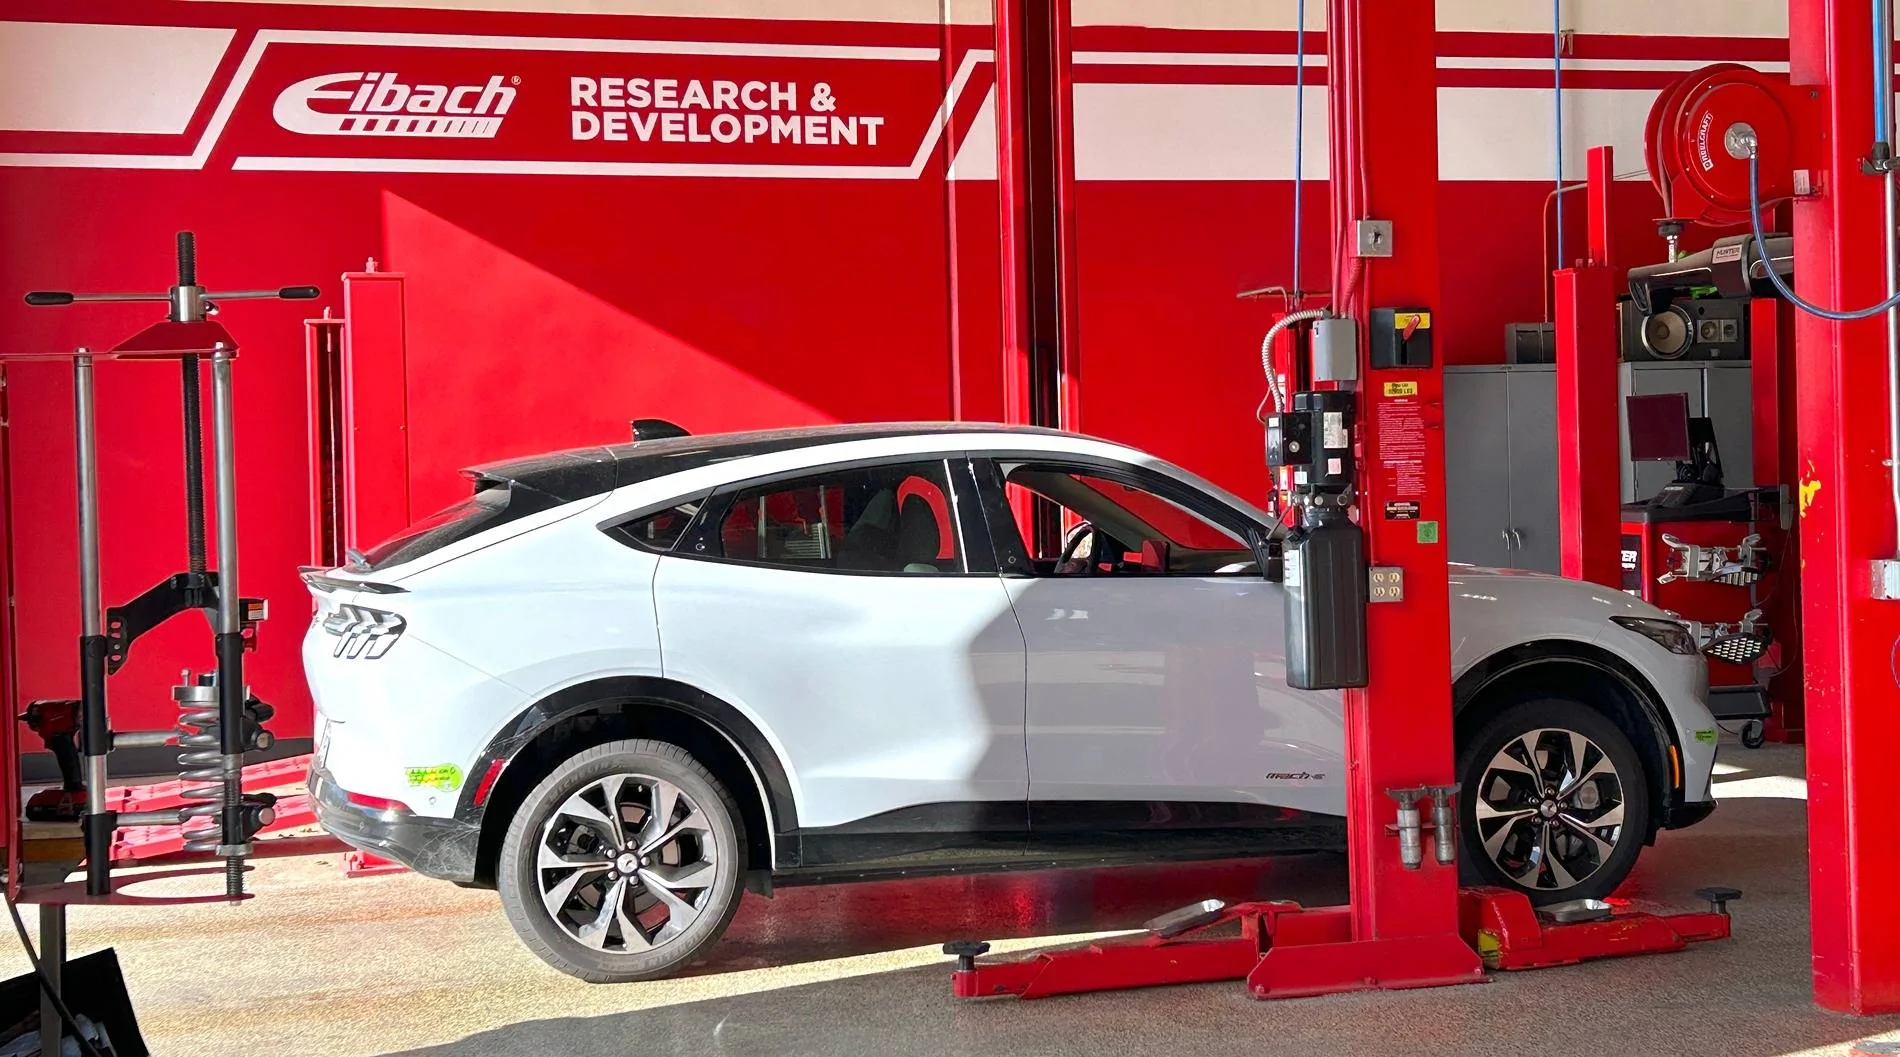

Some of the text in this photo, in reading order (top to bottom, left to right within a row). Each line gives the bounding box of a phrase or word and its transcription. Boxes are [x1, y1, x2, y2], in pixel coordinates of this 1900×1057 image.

[570, 76, 837, 112] RESEARCH &
[571, 110, 885, 145] DEVELOPMENT
